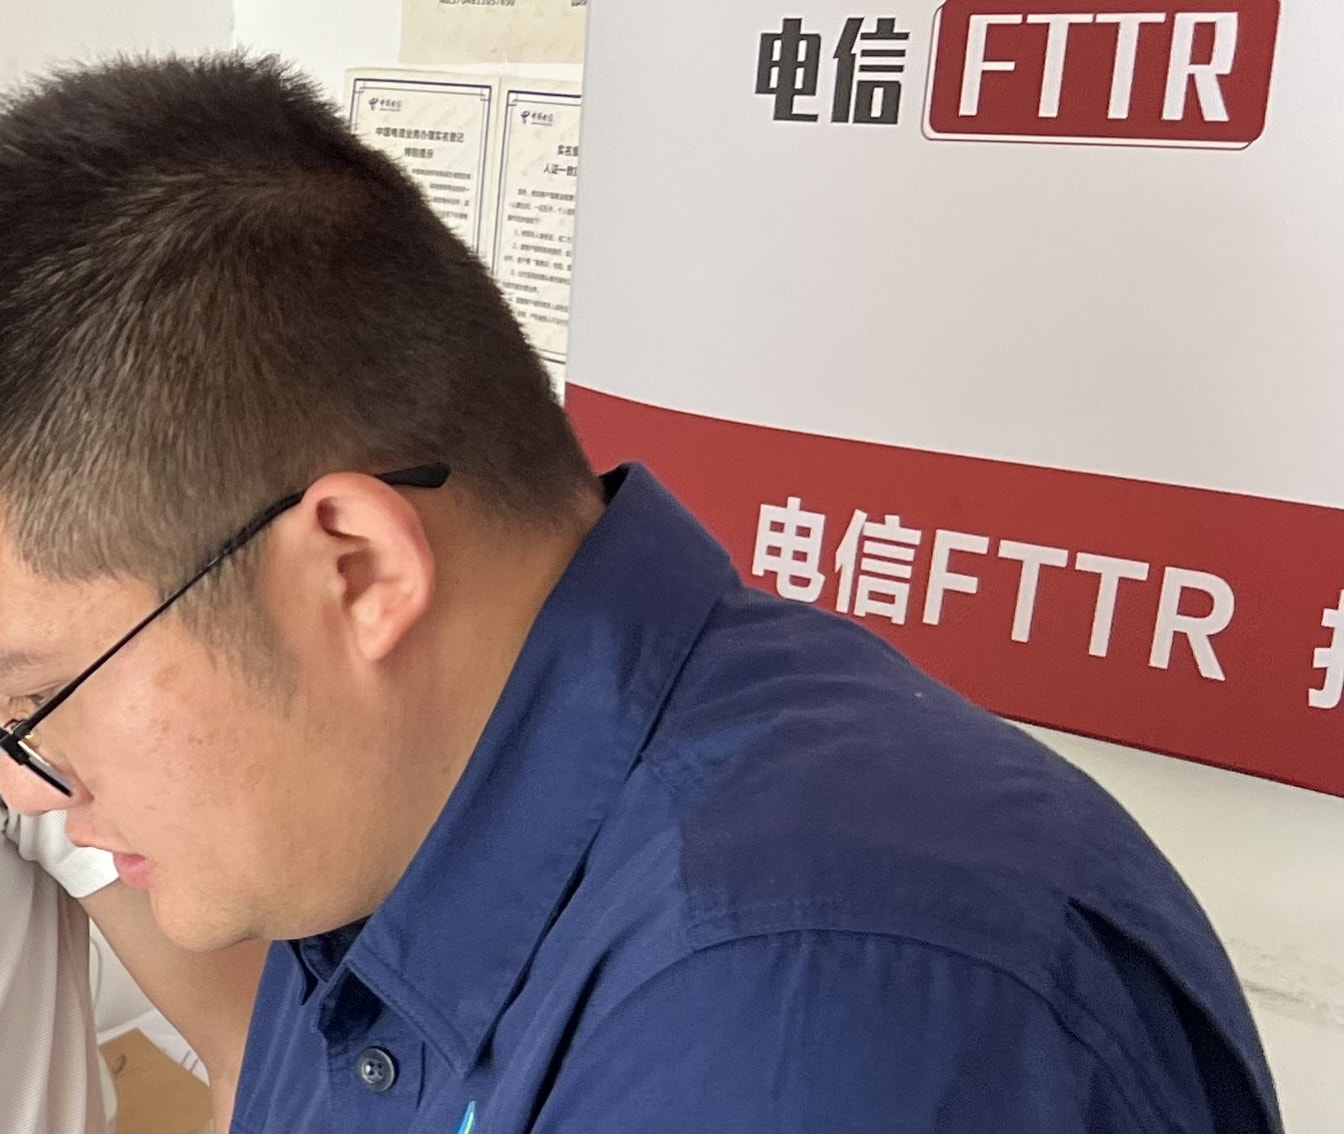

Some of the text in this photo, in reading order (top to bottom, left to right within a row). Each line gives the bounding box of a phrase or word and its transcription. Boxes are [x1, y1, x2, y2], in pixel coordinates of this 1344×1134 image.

[754, 11, 1239, 126] 电信 FTTR
[751, 496, 1237, 682] 电信FTTR
